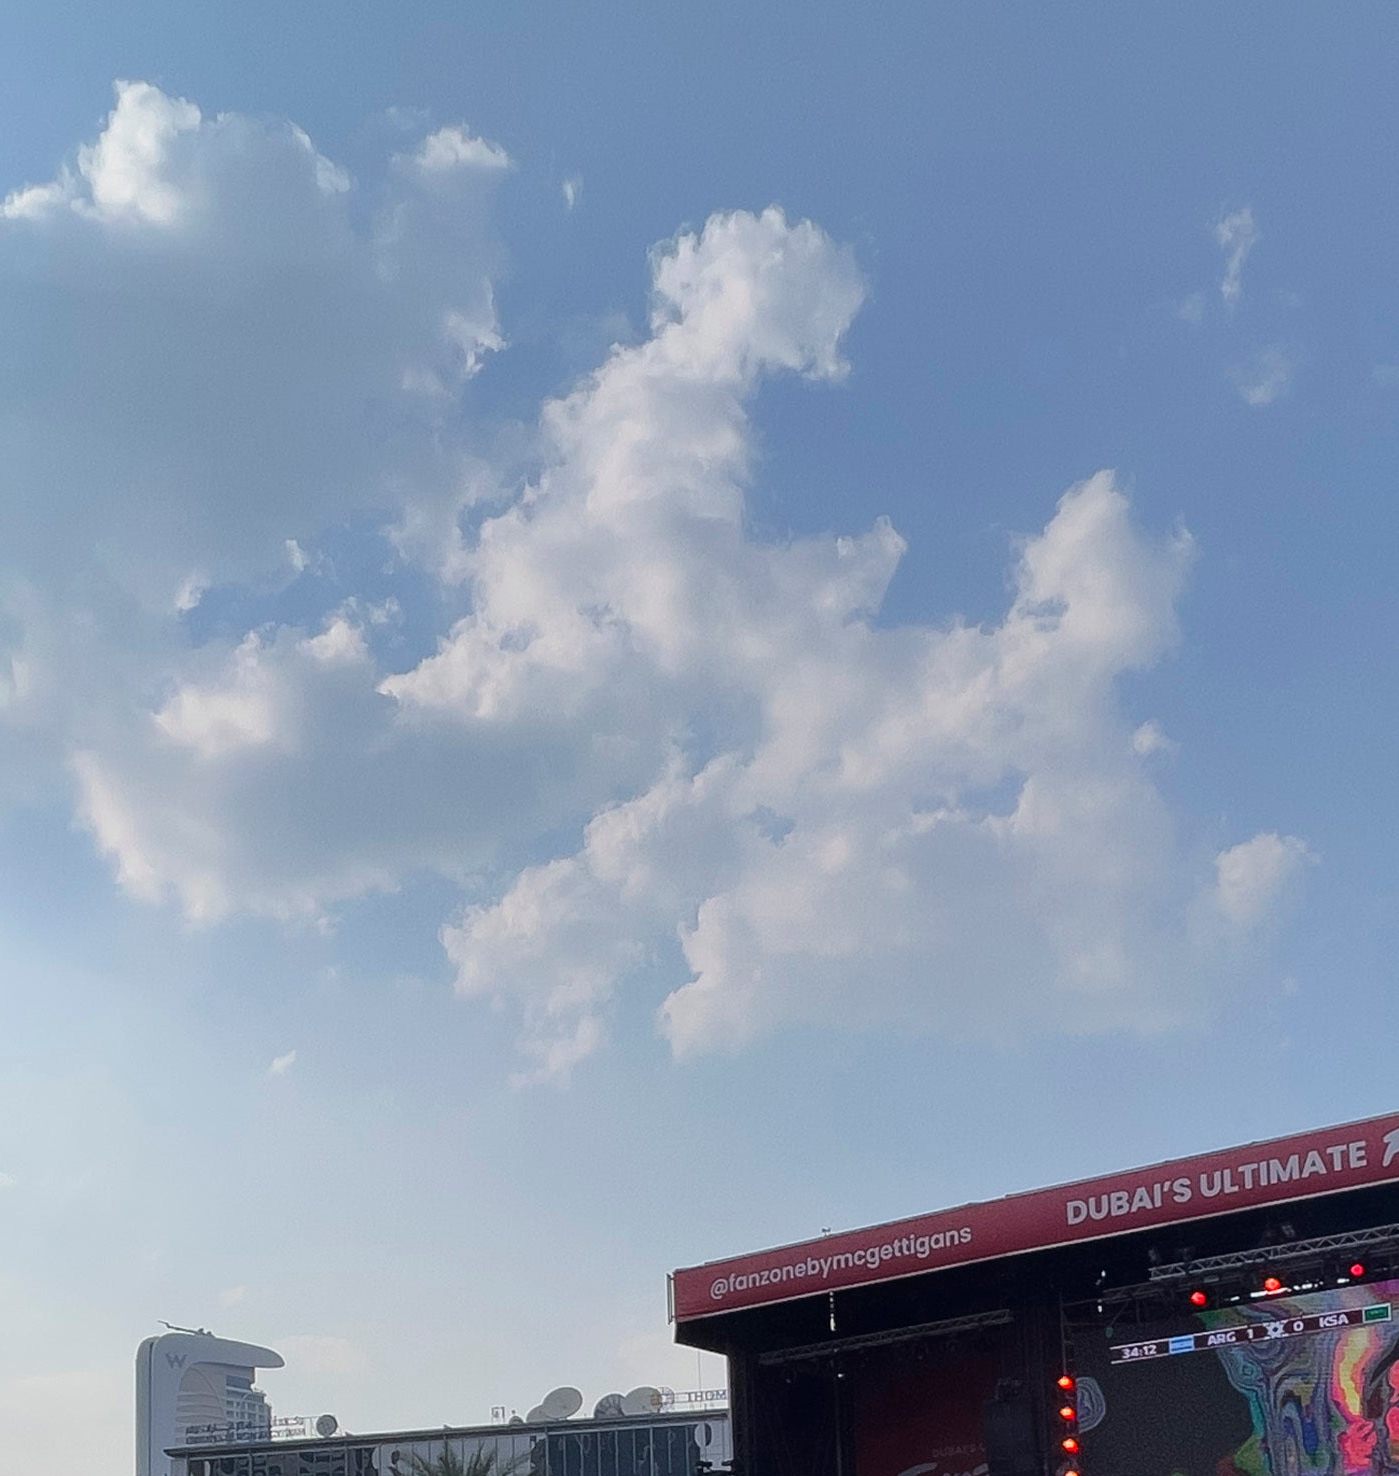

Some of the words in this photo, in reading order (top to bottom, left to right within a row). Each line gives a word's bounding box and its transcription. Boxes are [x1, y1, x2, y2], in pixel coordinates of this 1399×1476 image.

[1067, 1160, 1192, 1226] DUBAI'S
[1201, 1141, 1367, 1199] ULTIMATE
[710, 1224, 972, 1300] @fanzonebymcgettigans
[165, 1353, 188, 1368] W
[1121, 1344, 1157, 1360] 34:12
[1207, 1331, 1237, 1346] ARG
[1292, 1320, 1304, 1334] 0
[1318, 1312, 1349, 1328] KSA
